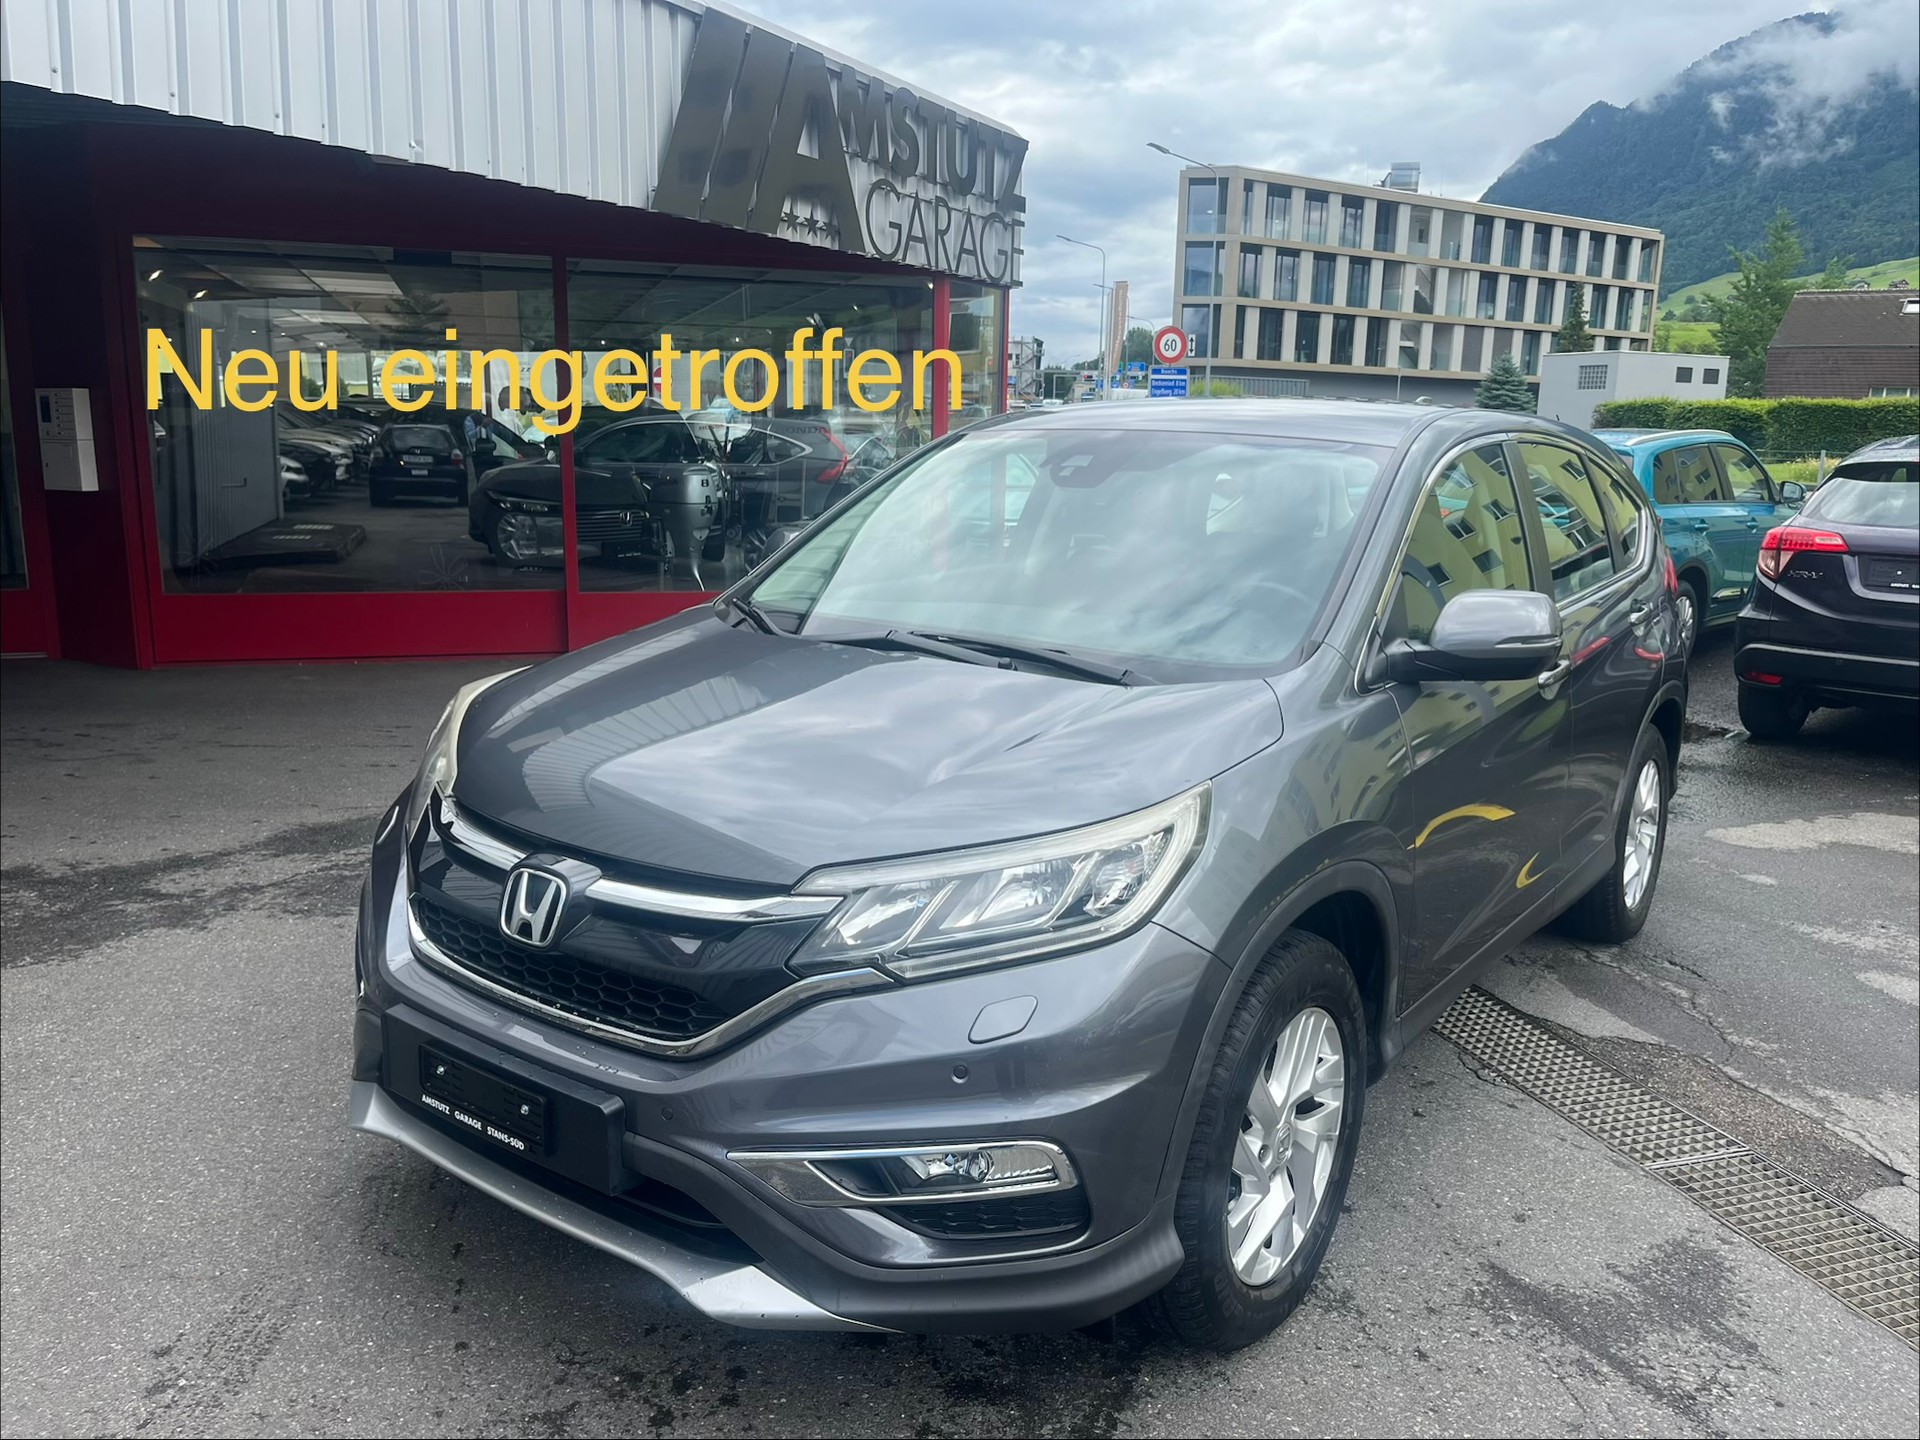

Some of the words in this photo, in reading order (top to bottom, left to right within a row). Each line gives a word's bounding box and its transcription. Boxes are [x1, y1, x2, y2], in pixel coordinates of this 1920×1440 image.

[747, 43, 1030, 253] AMSTUTZ
[866, 179, 1026, 287] GARAGE
[1164, 338, 1177, 352] 60
[421, 1094, 451, 1115] AMSTUTZ
[454, 1110, 483, 1131] GARAGE
[486, 1126, 525, 1151] STANS-SÜD
